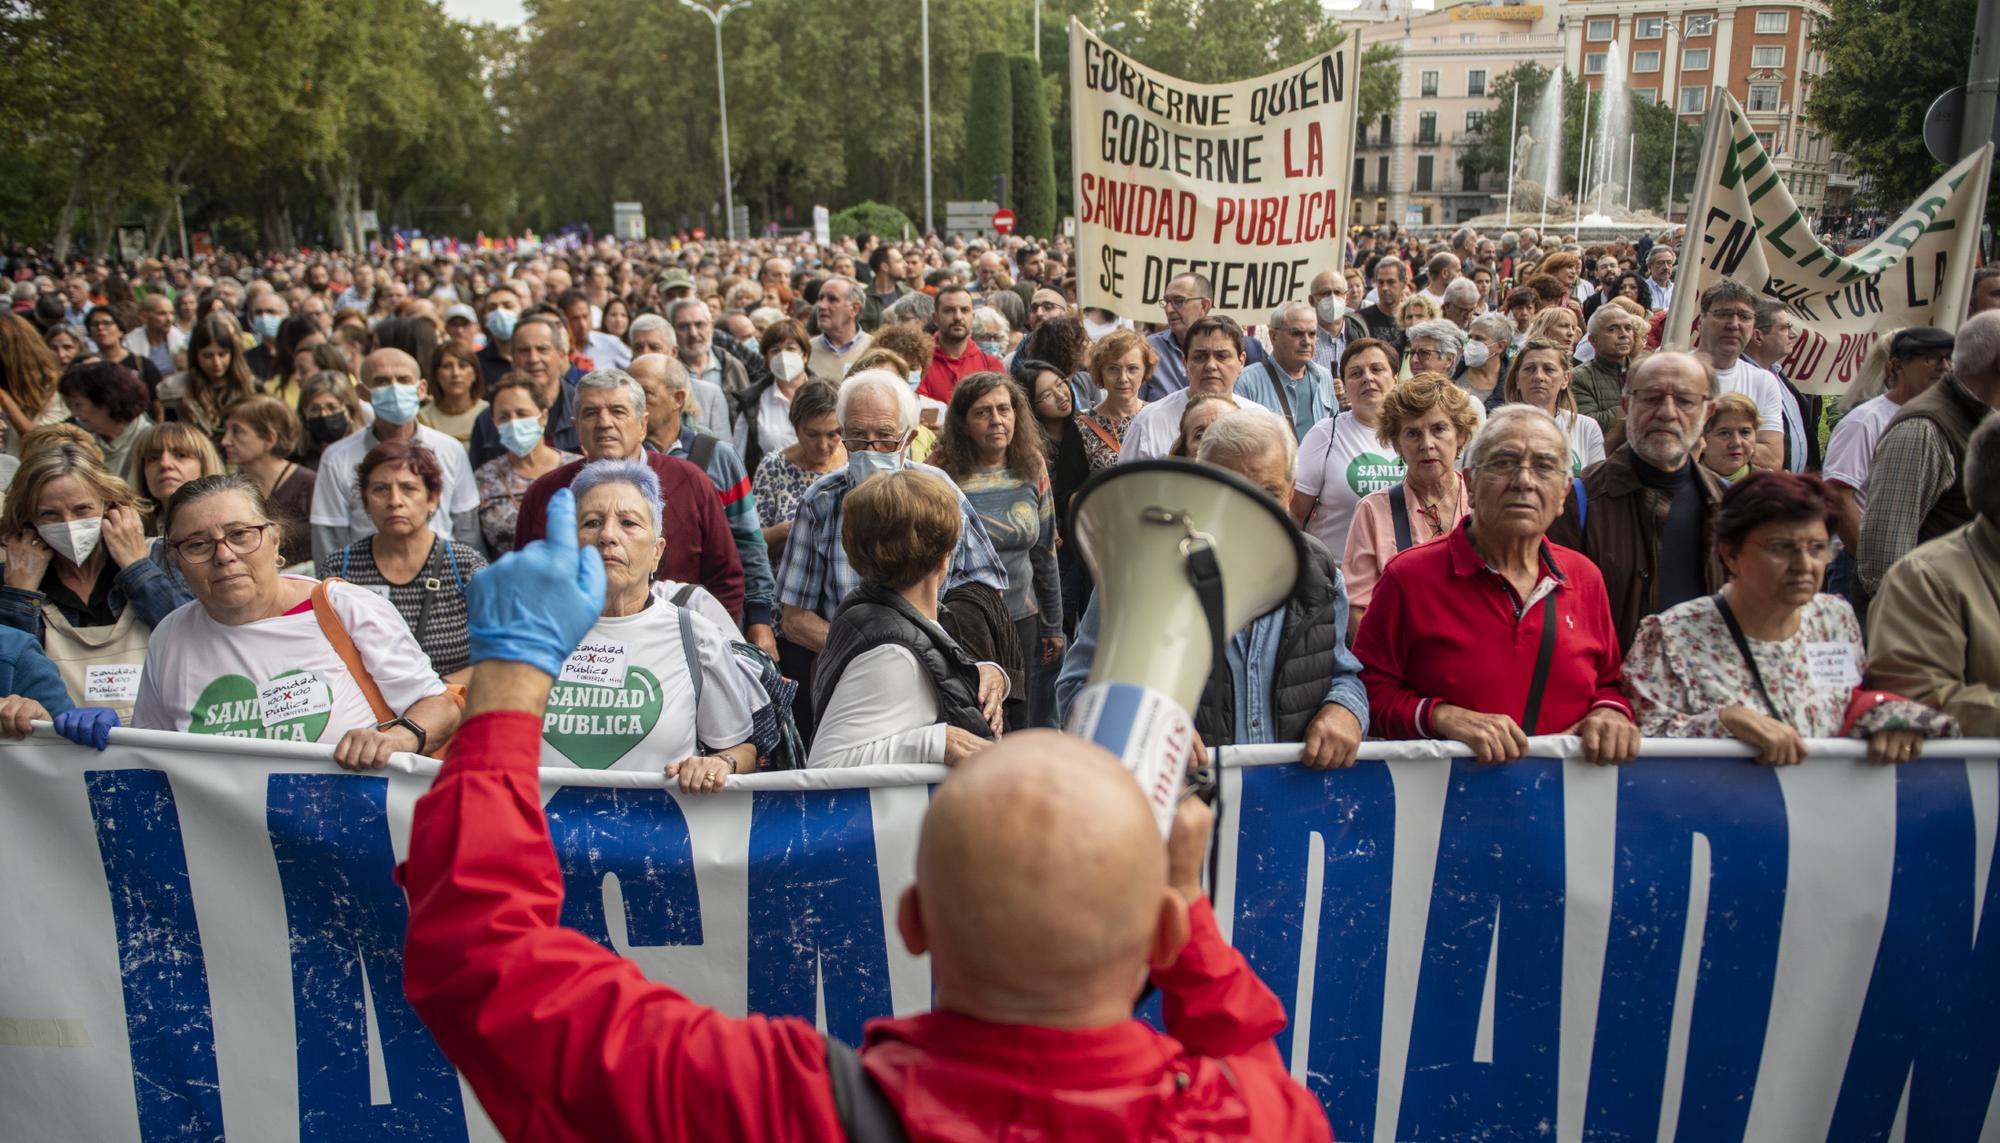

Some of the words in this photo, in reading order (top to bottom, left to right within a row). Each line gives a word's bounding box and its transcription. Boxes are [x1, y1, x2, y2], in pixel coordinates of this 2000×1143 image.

[1084, 38, 1234, 126] GOBIERNE
[1250, 50, 1344, 124] QUIEN
[1101, 110, 1264, 184] GOBIERNE
[1283, 122, 1324, 179] LA
[1081, 172, 1198, 243] SANIDAD
[1213, 189, 1337, 247] PUBLICA
[1100, 243, 1128, 299] SE
[1141, 254, 1310, 310] DIENDE
[1357, 464, 1408, 477] SANID
[565, 663, 609, 676] Pública
[262, 674, 318, 699] Sanidad
[548, 686, 645, 708] SANIDAD
[204, 697, 263, 727] SANI
[265, 698, 309, 719] Pública
[542, 708, 643, 734] PÚBLICA
